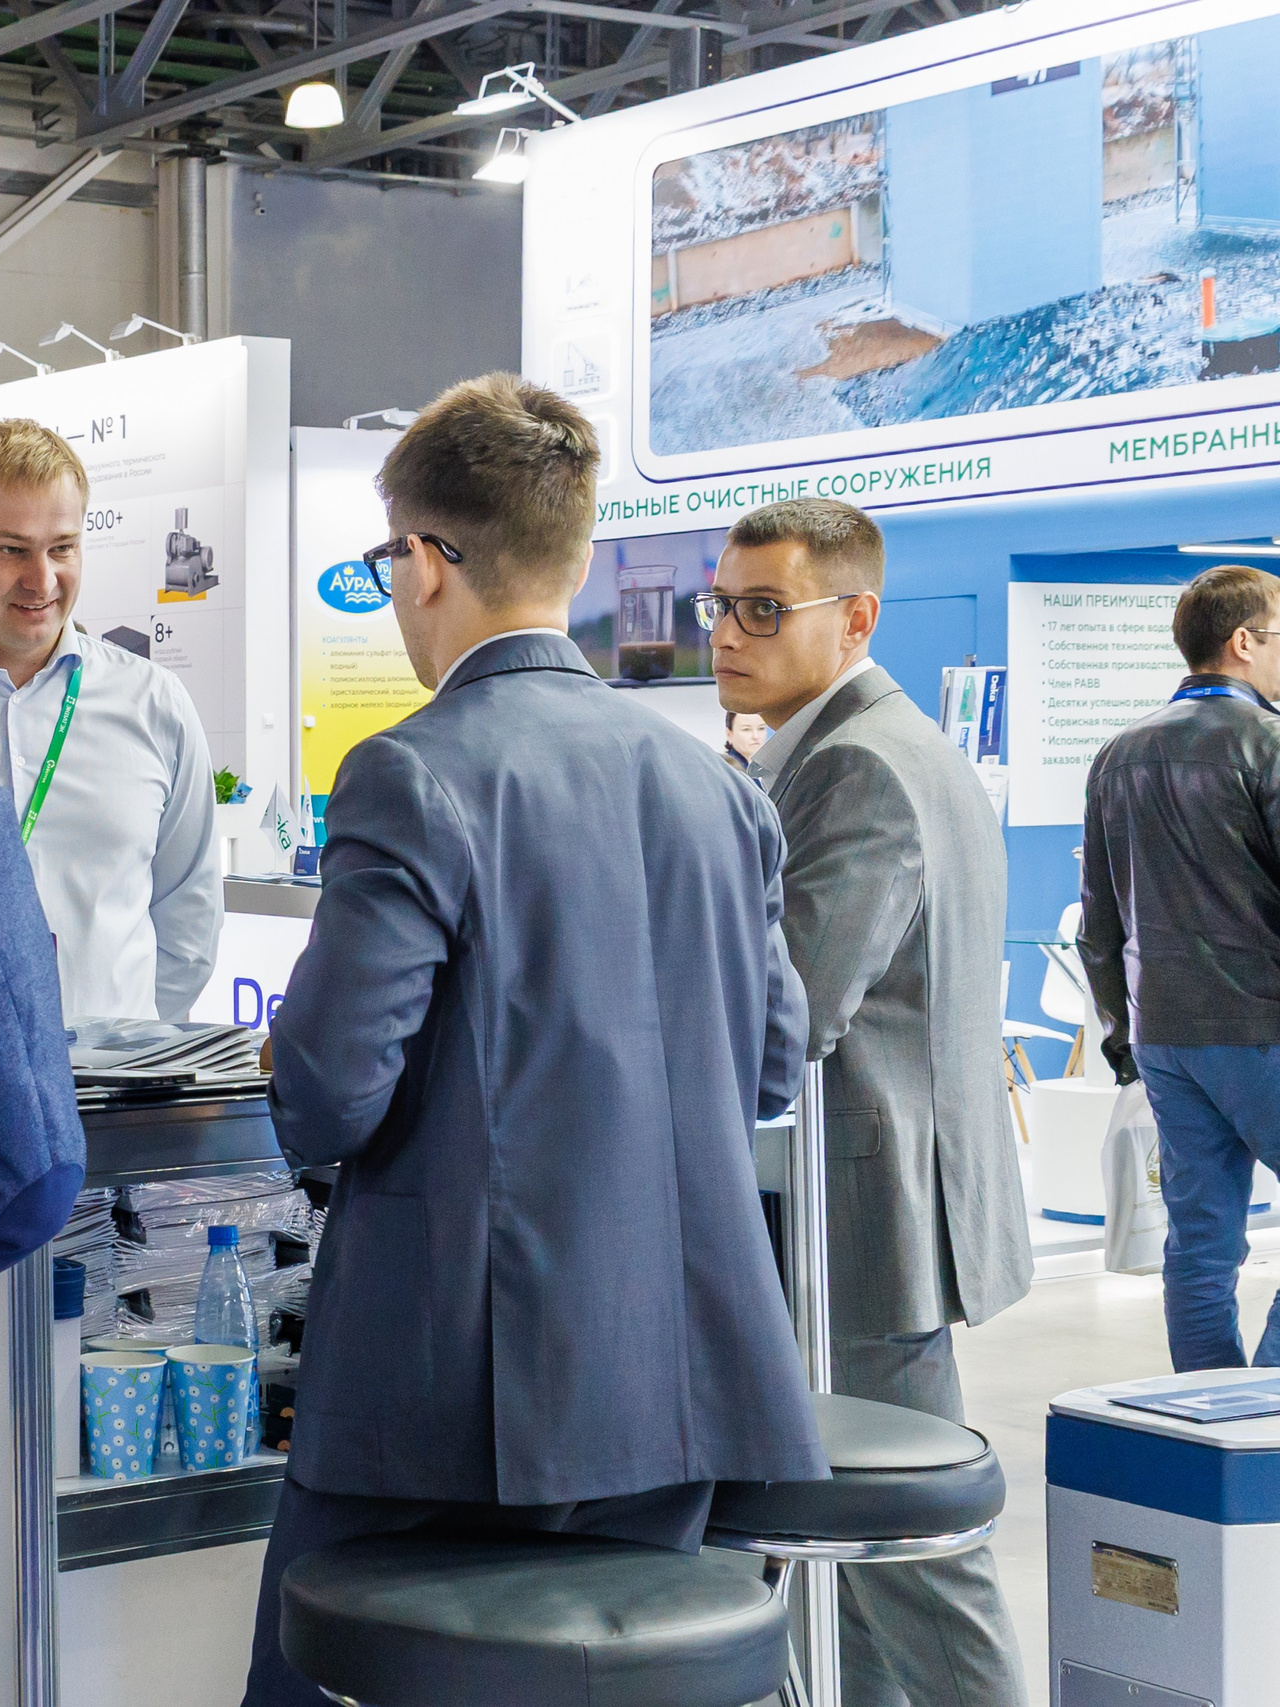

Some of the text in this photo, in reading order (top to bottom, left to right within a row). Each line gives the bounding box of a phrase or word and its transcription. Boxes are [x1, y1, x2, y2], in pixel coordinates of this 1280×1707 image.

[120, 414, 126, 439] 1
[598, 456, 992, 522] УЛЬНЫЕ ОЧИСТНЫЕ СООРУЖЕНИЯ
[86, 509, 123, 531] 500+
[329, 571, 381, 591] АУРА
[1043, 594, 1178, 609] НАШИ ПРЕИМУЩЕСТВ
[155, 622, 173, 643] 8+
[1048, 621, 1057, 632] 17
[1059, 623, 1075, 632] лет
[1078, 623, 1106, 632] опыта
[1109, 624, 1115, 632] в
[1117, 622, 1145, 634] сфере
[322, 636, 368, 644] КОАГУЛЯНТЫ
[1048, 640, 1109, 651] Собственное
[366, 650, 392, 658] сульфат
[1048, 659, 1109, 670] Собственная
[988, 675, 1000, 702] Deka
[1048, 678, 1100, 689] Член РАВВ
[330, 702, 359, 710] хлорное
[1048, 697, 1088, 709] Десятки
[1090, 698, 1130, 710] успешно
[1048, 716, 1100, 728] Сервисная
[1042, 755, 1081, 765] заказов
